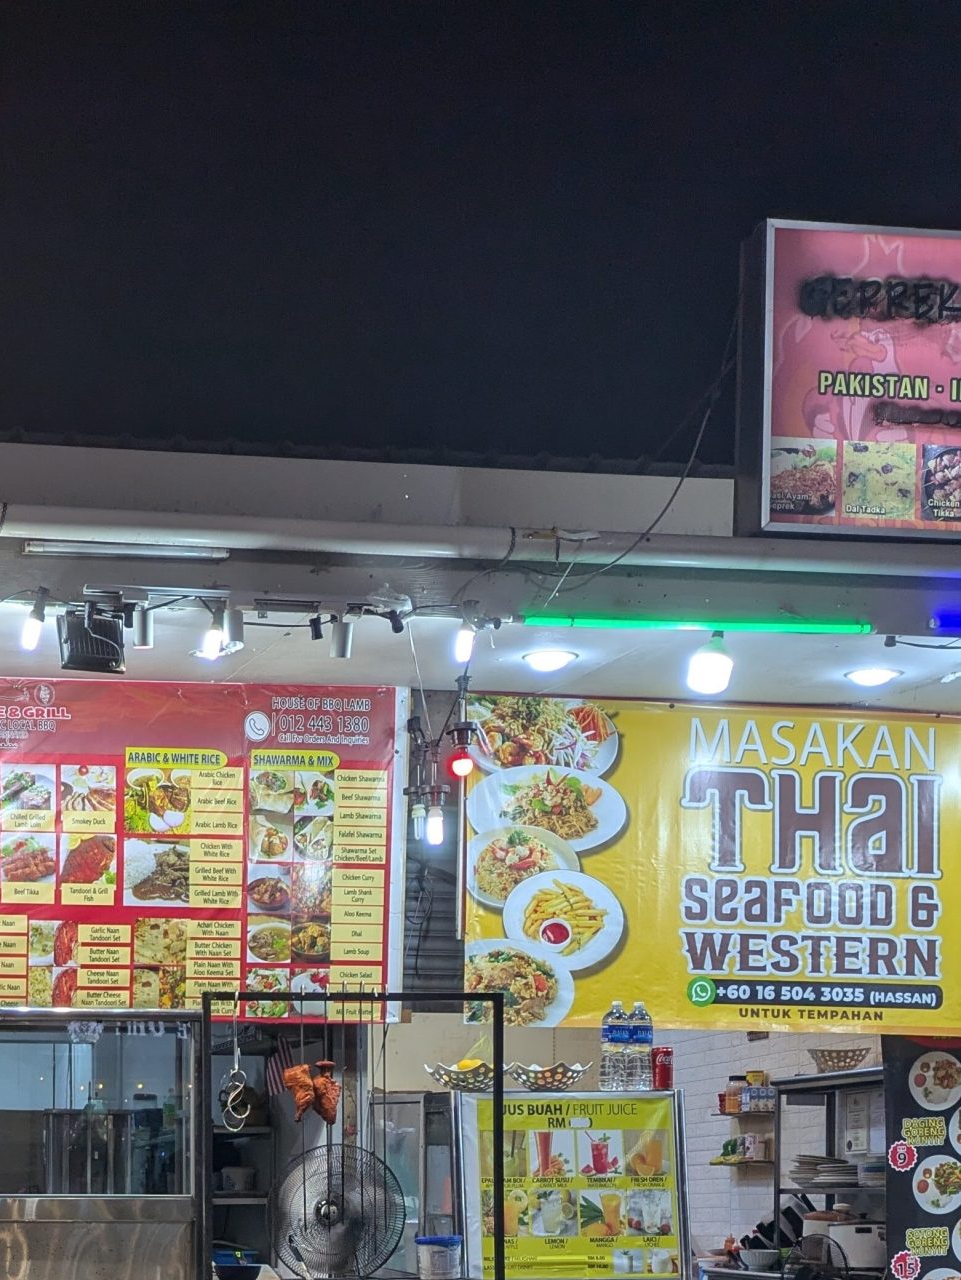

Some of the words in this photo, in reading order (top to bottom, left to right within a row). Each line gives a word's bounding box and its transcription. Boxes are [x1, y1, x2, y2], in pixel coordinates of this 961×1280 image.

[819, 371, 928, 399] PAKISTAN
[928, 499, 960, 507] Chicken
[846, 505, 859, 513] Dal
[862, 506, 886, 514] Tadka
[933, 509, 954, 517] Tikka
[272, 697, 305, 710] HOUSE
[306, 697, 320, 710] OF
[322, 698, 342, 712] BBQ
[344, 699, 371, 711] LAMB
[7, 706, 20, 718] &
[22, 706, 71, 719] GRILL
[8, 720, 36, 730] LOCAL
[38, 720, 56, 732] BBQ
[279, 715, 304, 732] 012
[308, 715, 332, 732] 443
[338, 716, 370, 733] 1380
[278, 734, 291, 743] Call
[292, 734, 303, 743] For
[304, 734, 326, 744] Orders
[327, 735, 340, 743] And
[341, 735, 369, 745] Inquiries
[689, 717, 937, 771] MASAKAN
[128, 752, 160, 763] ARABIC
[163, 754, 168, 763] &
[171, 754, 199, 764] WHITE
[201, 754, 220, 764] RICE
[254, 755, 305, 766] SHAWARMA
[308, 755, 315, 766] &
[317, 755, 334, 766] MIX
[910, 882, 940, 930] &
[683, 931, 939, 978] WESTERN
[716, 985, 750, 1000] +60
[756, 985, 776, 1000] 16
[780, 986, 815, 1001] 504
[820, 987, 865, 1002] 3035
[869, 991, 937, 1007] (HASSAN)
[739, 1008, 792, 1019] UNTUK
[798, 1009, 883, 1021] TEMPAHAN
[503, 1104, 524, 1115] JUS
[527, 1104, 563, 1115] BUAH
[573, 1104, 604, 1115] FRUIT
[607, 1104, 637, 1115] JUICE
[548, 1118, 566, 1128] RM
[904, 1119, 944, 1128] DAGING
[903, 1128, 945, 1136] GORENG
[897, 1152, 908, 1166] 9
[896, 1262, 915, 1276] 15
